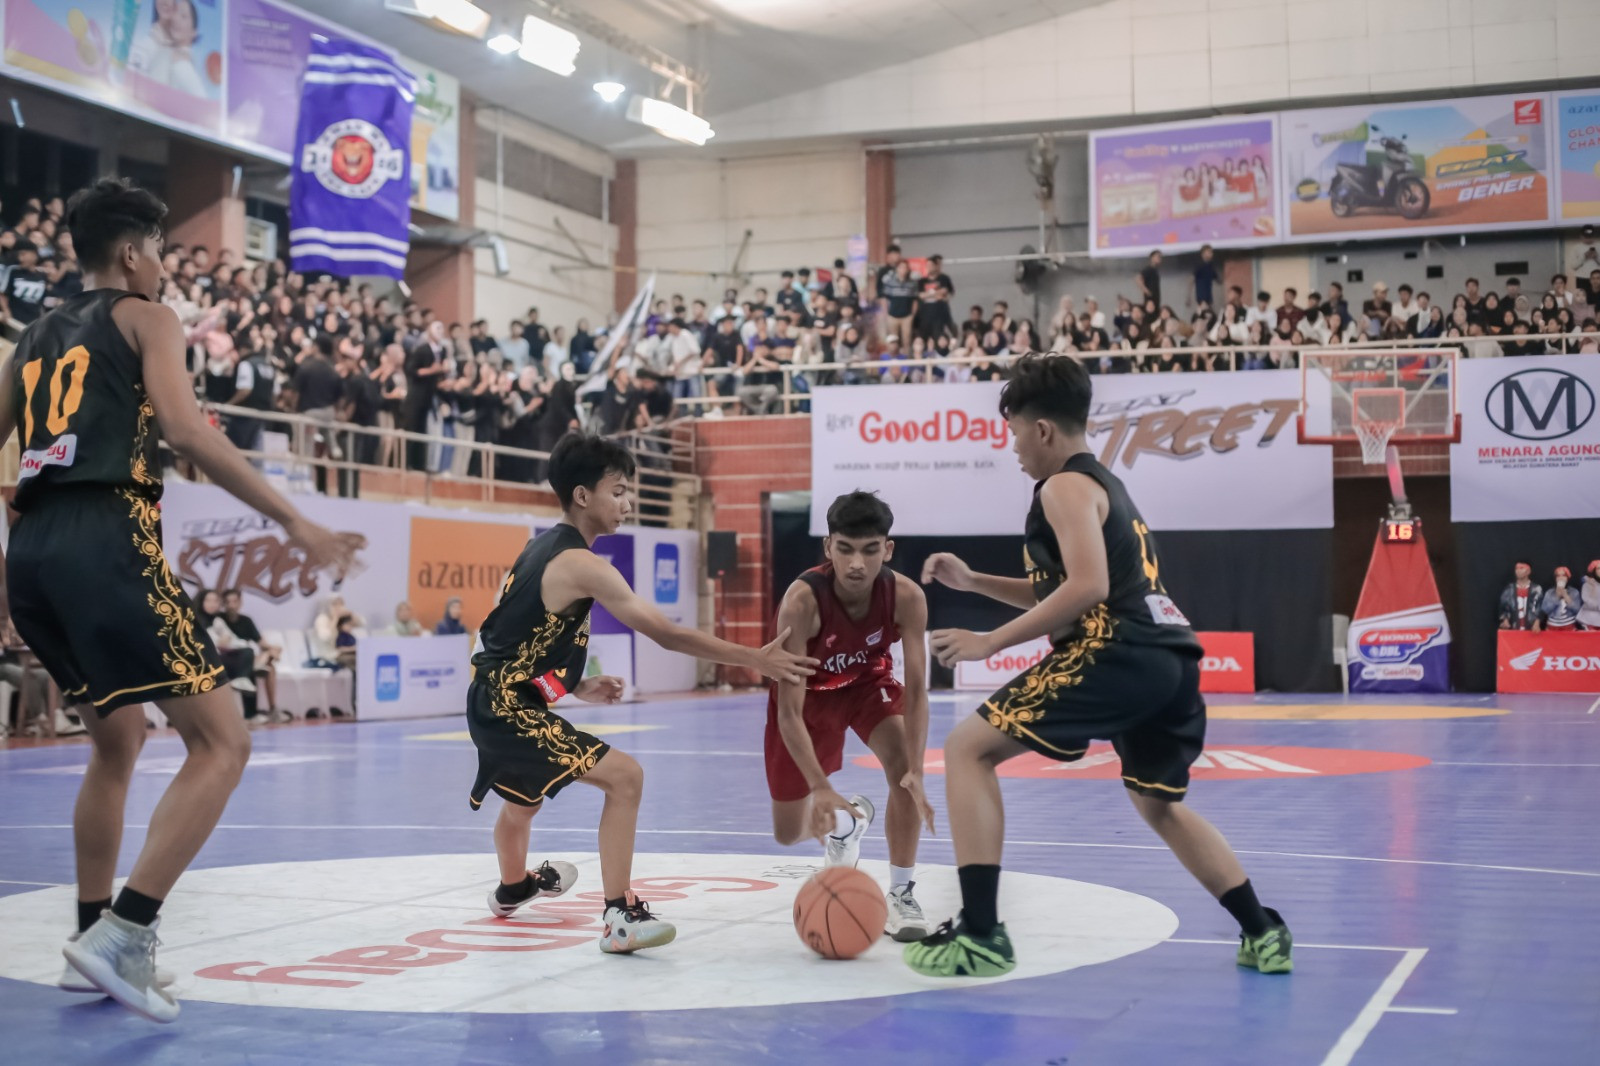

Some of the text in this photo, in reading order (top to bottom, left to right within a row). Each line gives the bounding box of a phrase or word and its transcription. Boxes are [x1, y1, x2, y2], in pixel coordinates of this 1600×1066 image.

[22, 345, 90, 448] 10
[1087, 398, 1307, 470] TREET
[1478, 446, 1543, 457] MENARA
[1388, 524, 1413, 540] 16
[178, 535, 344, 604] STREE
